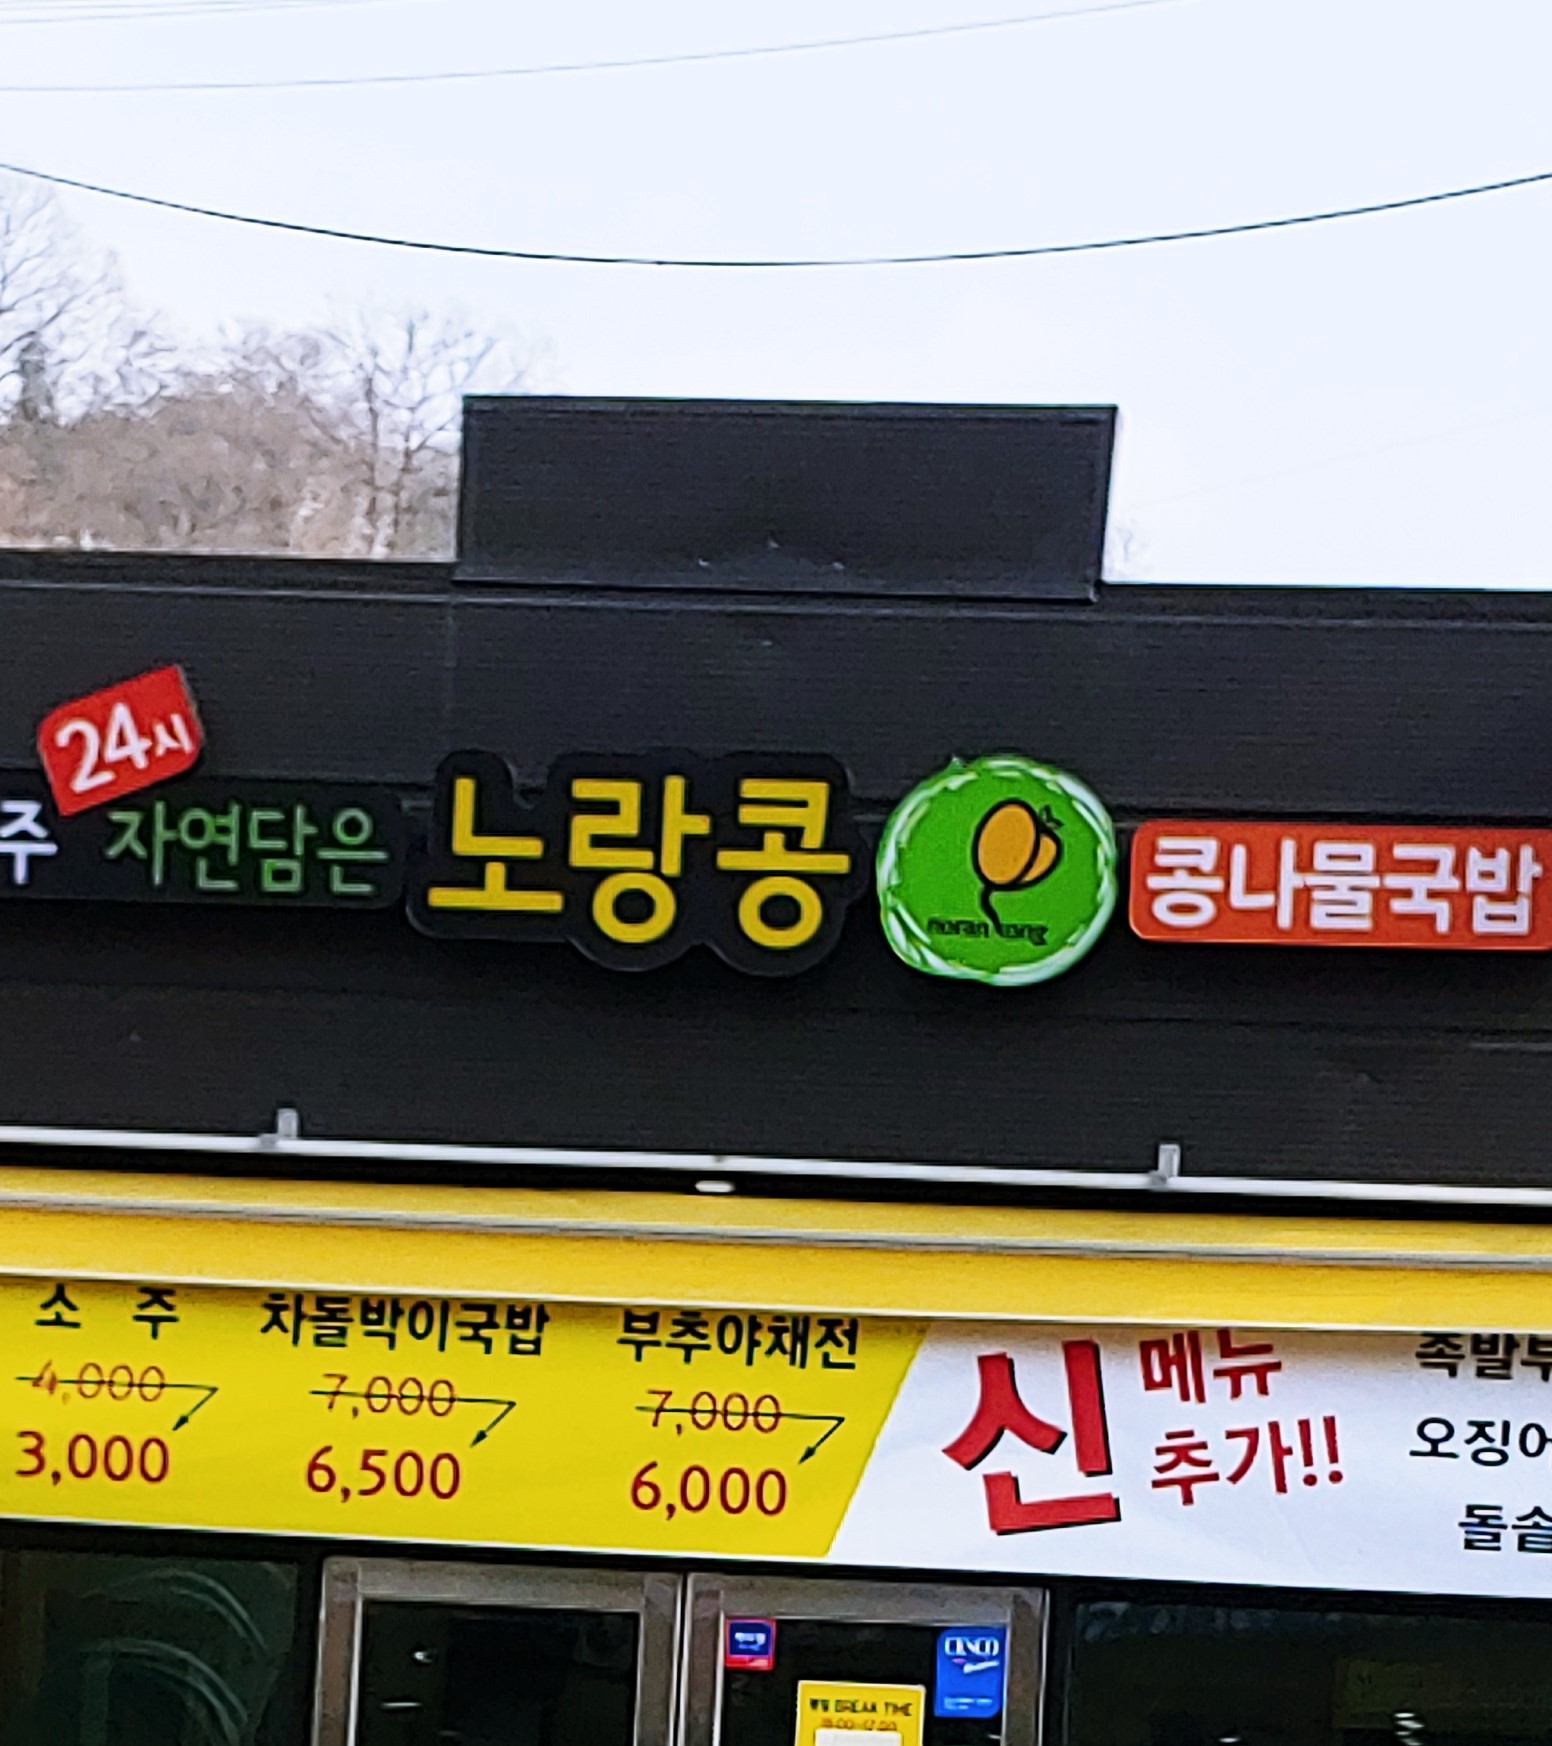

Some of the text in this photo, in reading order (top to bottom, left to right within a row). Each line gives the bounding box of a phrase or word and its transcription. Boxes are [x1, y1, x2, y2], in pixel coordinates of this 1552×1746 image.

[56, 702, 192, 793] 24시
[104, 802, 388, 896] 자연담은
[428, 775, 850, 949] 노랑콩
[1147, 836, 1542, 934] 콩나물국밥
[261, 1294, 549, 1356] 차돌박이국밥
[617, 1308, 859, 1369] 부추야채전
[1140, 1328, 1282, 1404] 메뉴
[15, 1431, 170, 1486] 3,000
[306, 1446, 461, 1502] 6,500
[942, 1340, 1121, 1535] 신
[1151, 1416, 1343, 1506] 추가!!
[630, 1461, 788, 1520] 6,000
